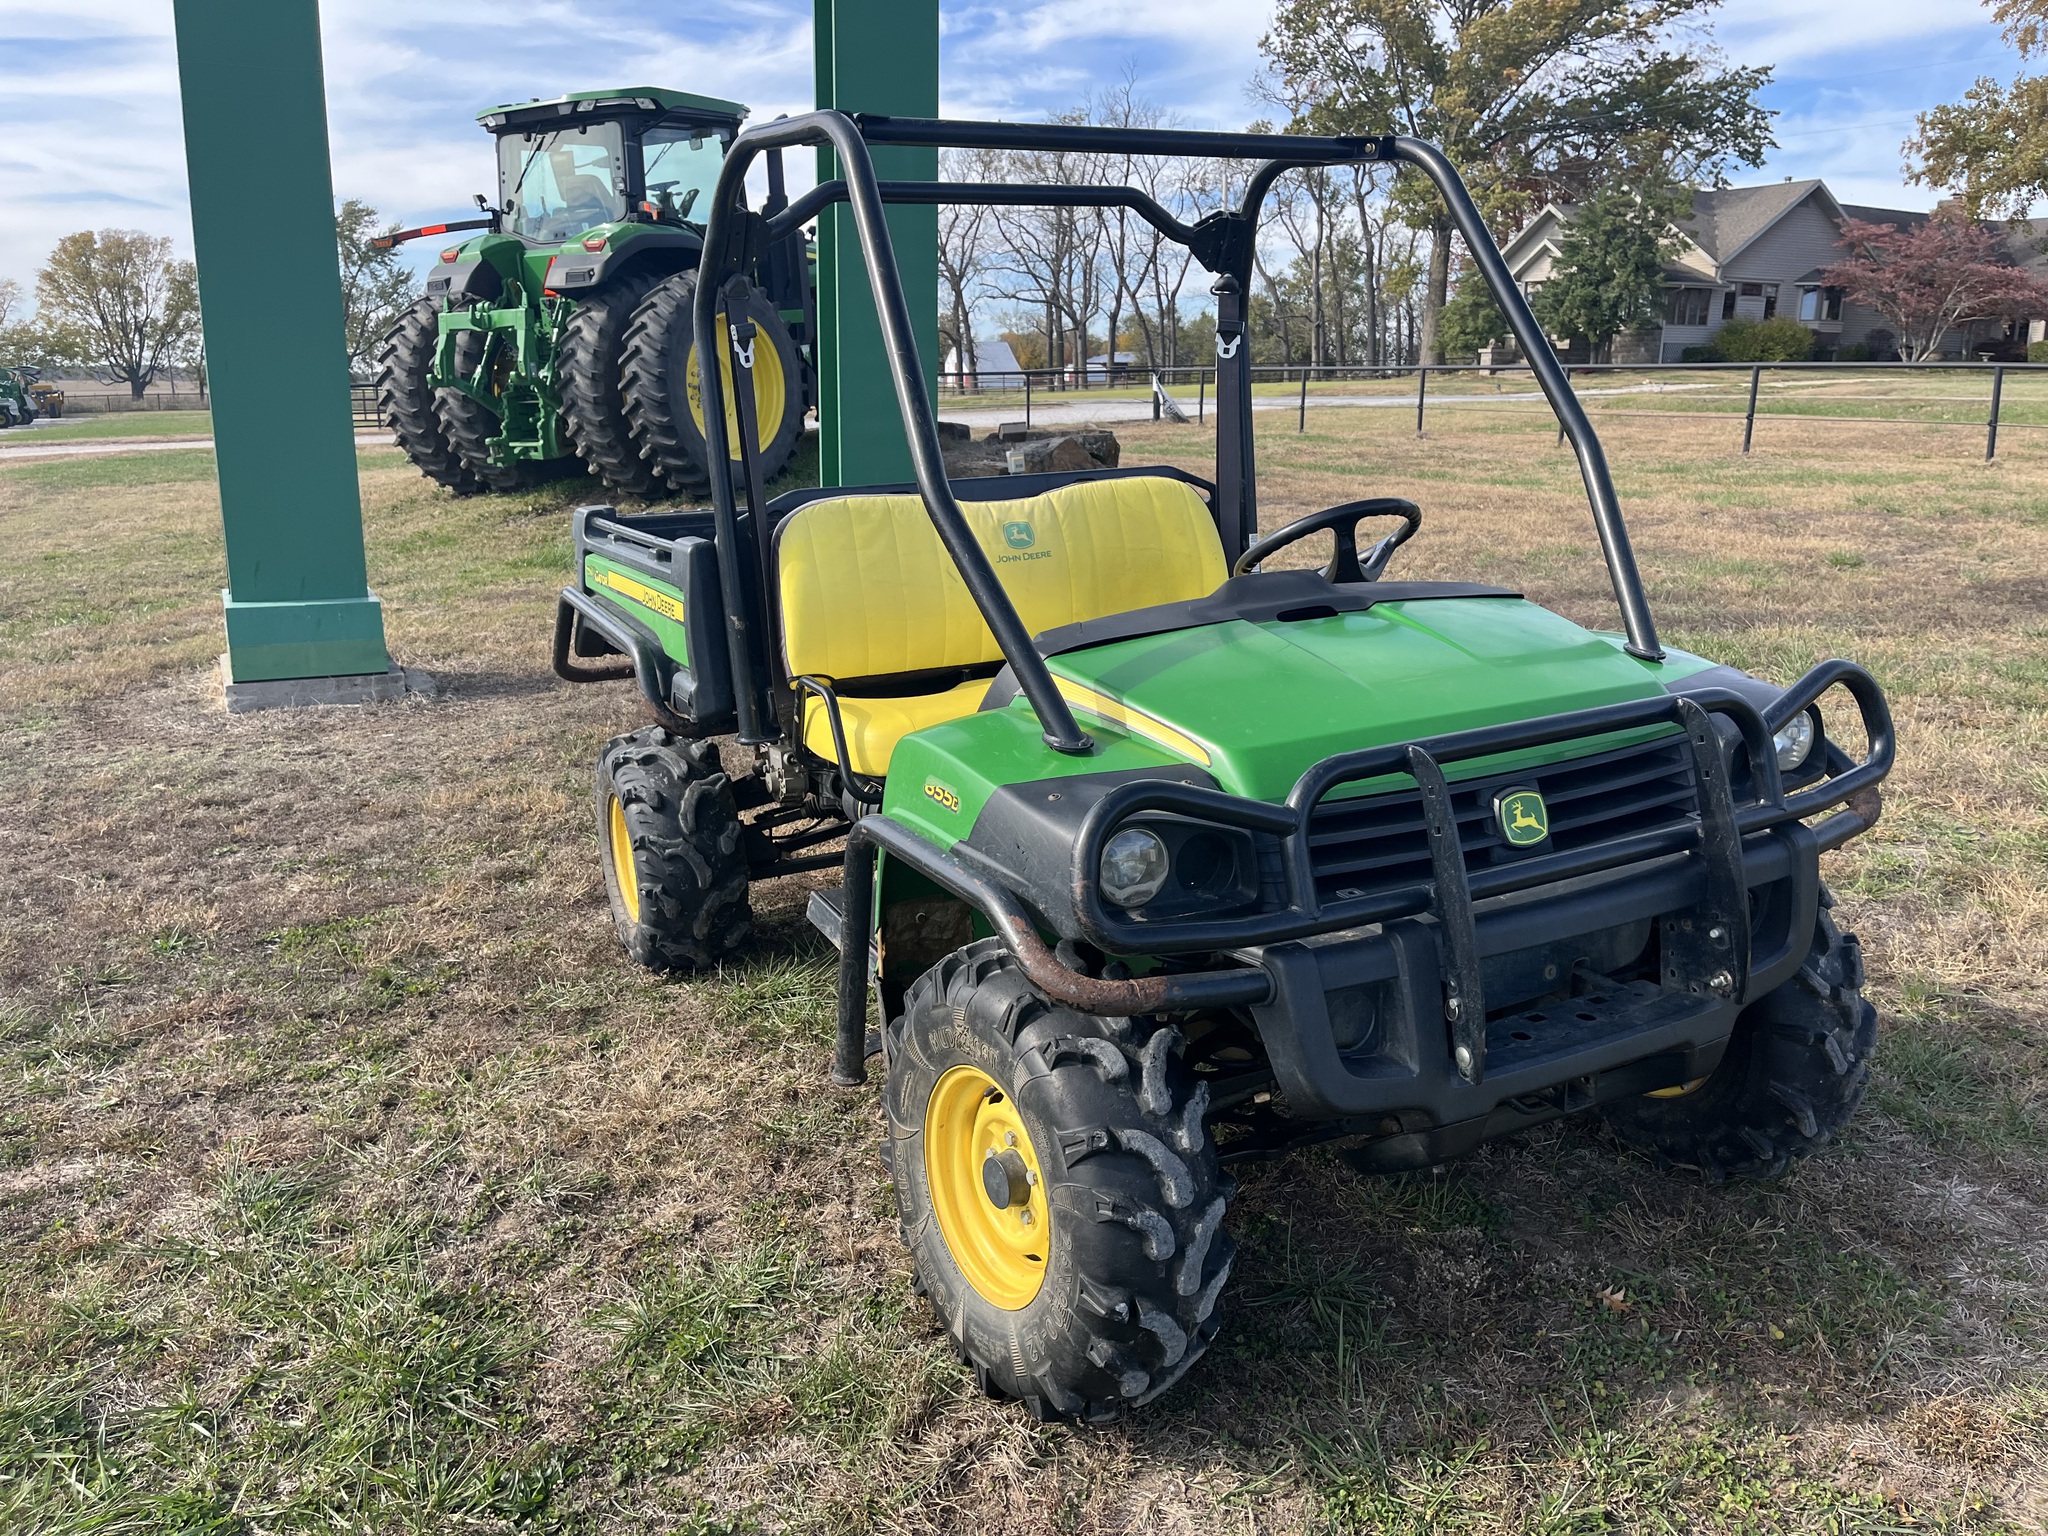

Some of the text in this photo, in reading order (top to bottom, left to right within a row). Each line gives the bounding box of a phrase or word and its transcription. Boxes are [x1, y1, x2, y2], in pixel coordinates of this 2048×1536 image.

[996, 550, 1052, 563] JOHN DEERE
[642, 588, 677, 620] JOHN DEERE
[895, 1141, 914, 1213] KING
